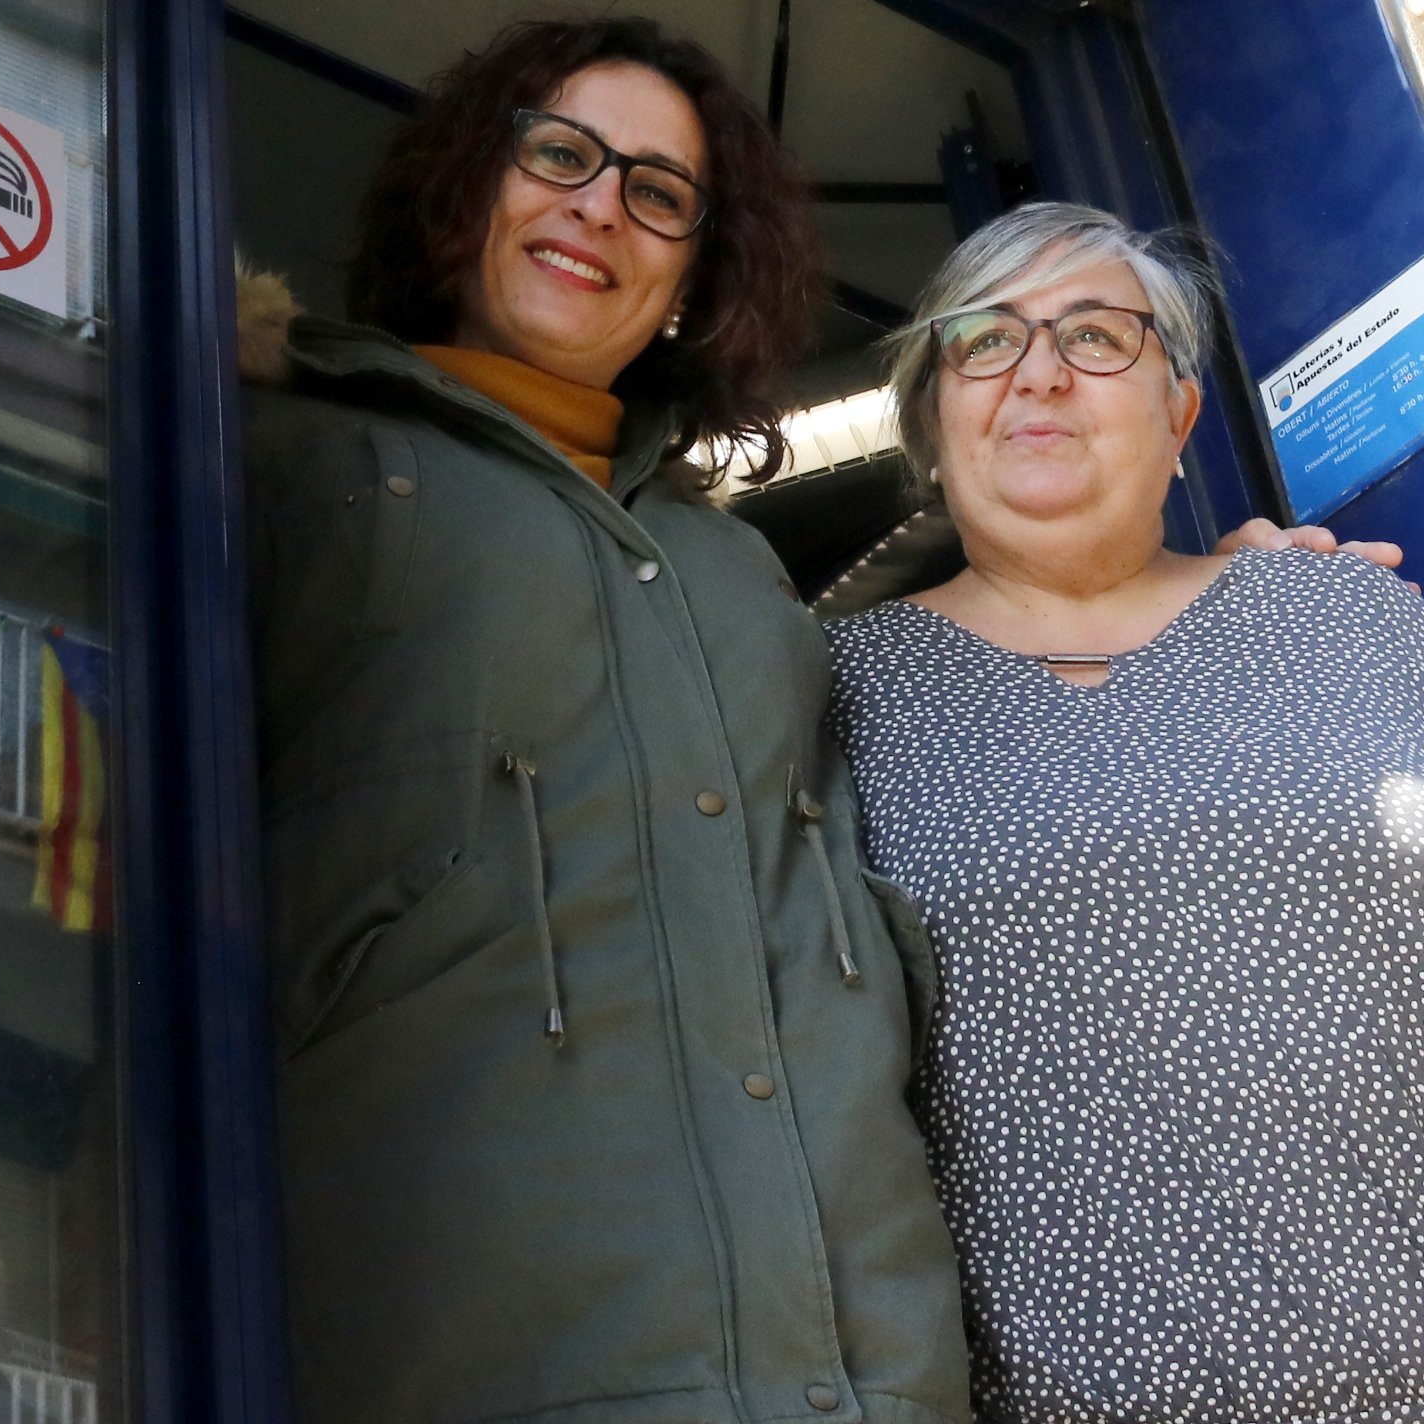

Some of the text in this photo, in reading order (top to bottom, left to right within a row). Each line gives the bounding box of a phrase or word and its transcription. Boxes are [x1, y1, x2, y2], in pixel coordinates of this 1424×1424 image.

[1293, 337, 1343, 377] Loterías y
[1297, 307, 1400, 390] Apuestas del Estado
[1278, 411, 1307, 438] OBERT
[1317, 380, 1349, 410] ABIERTO
[1296, 421, 1319, 441] Dilluns
[1327, 389, 1361, 418] Divendres
